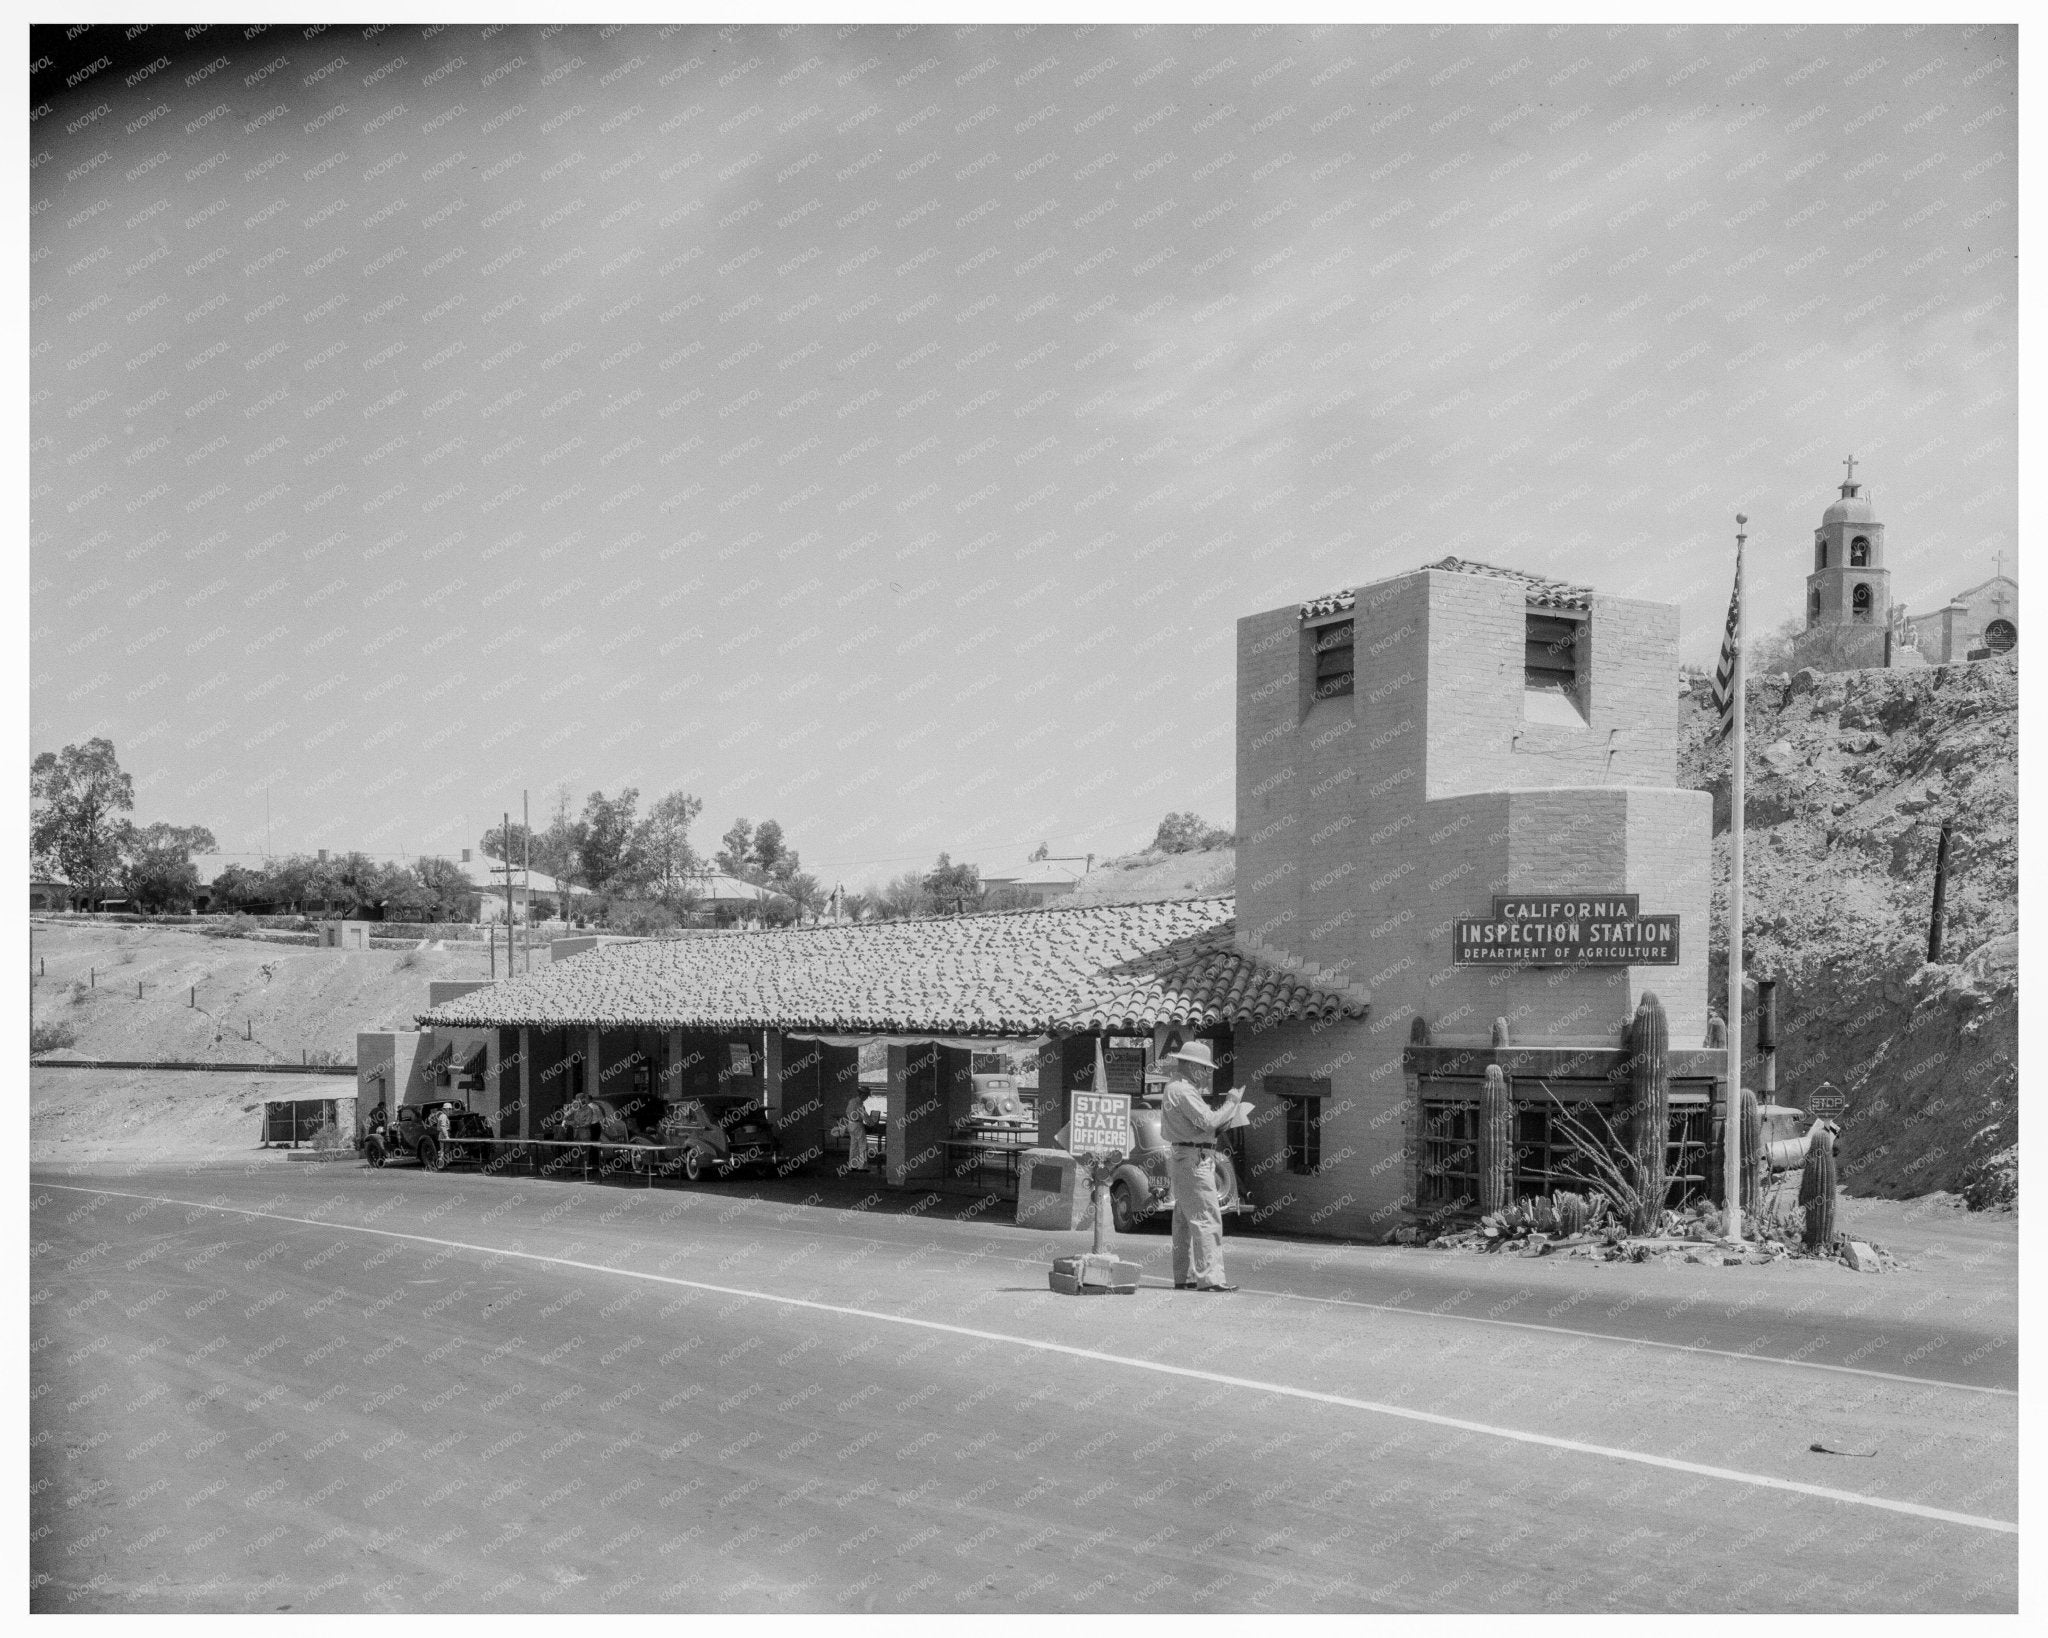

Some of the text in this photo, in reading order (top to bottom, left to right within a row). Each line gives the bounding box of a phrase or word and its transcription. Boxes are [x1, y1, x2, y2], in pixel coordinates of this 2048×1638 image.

[1504, 903, 1627, 917] CALIFORNIA
[1463, 924, 1670, 942] INSPECTION STATION
[1464, 947, 1667, 958] DEPARTMENT OF AGRICULTURE
[1077, 1097, 1124, 1113] STOP
[1812, 1097, 1842, 1109] STOP
[1075, 1113, 1126, 1130] STATE
[1074, 1128, 1126, 1146] OFFICERS
